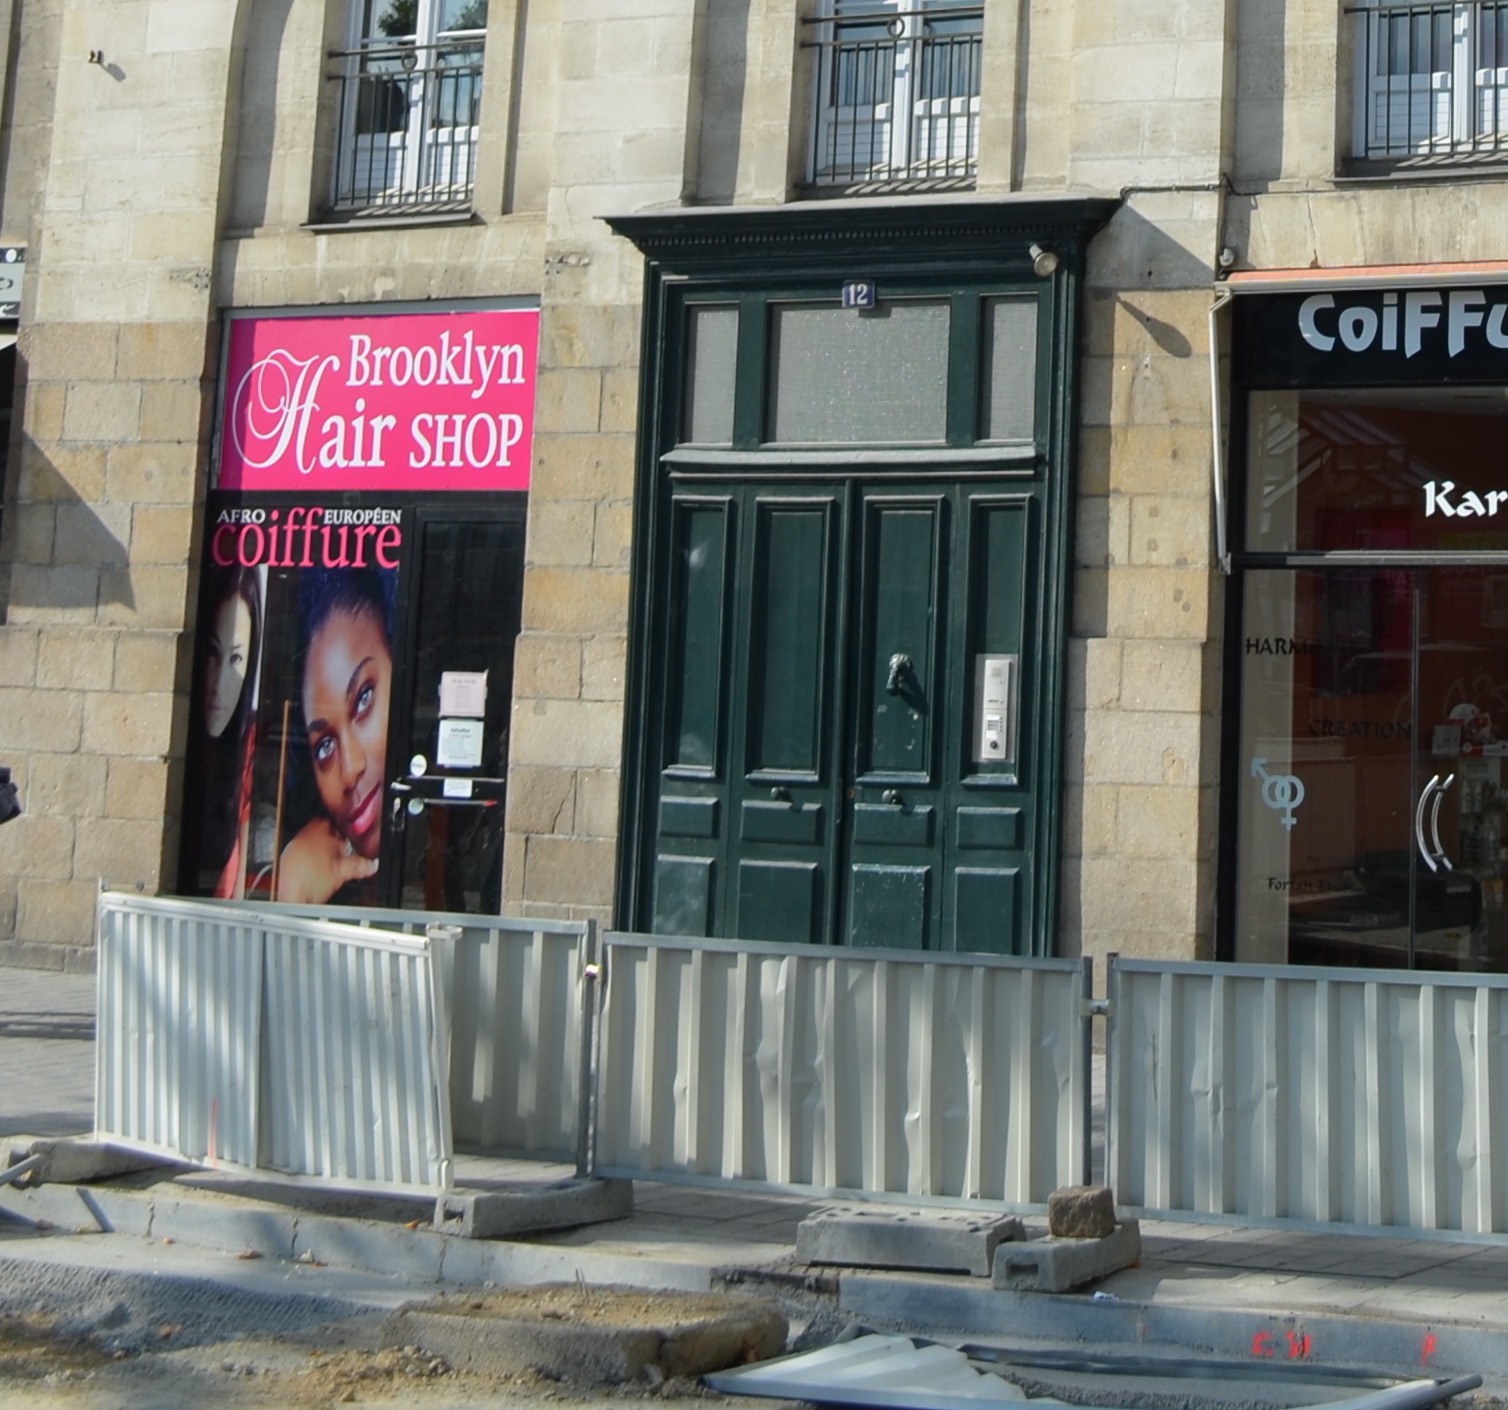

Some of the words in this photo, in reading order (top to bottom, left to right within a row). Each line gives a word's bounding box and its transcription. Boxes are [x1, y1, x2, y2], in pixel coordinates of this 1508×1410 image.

[849, 283, 868, 305] 12
[346, 329, 526, 399] Brooklyn
[232, 348, 397, 475] Hair
[409, 412, 524, 469] SHOP
[211, 506, 402, 569] coiffure
[217, 509, 266, 523] AFRO
[323, 507, 402, 525] EUROPÉEN
